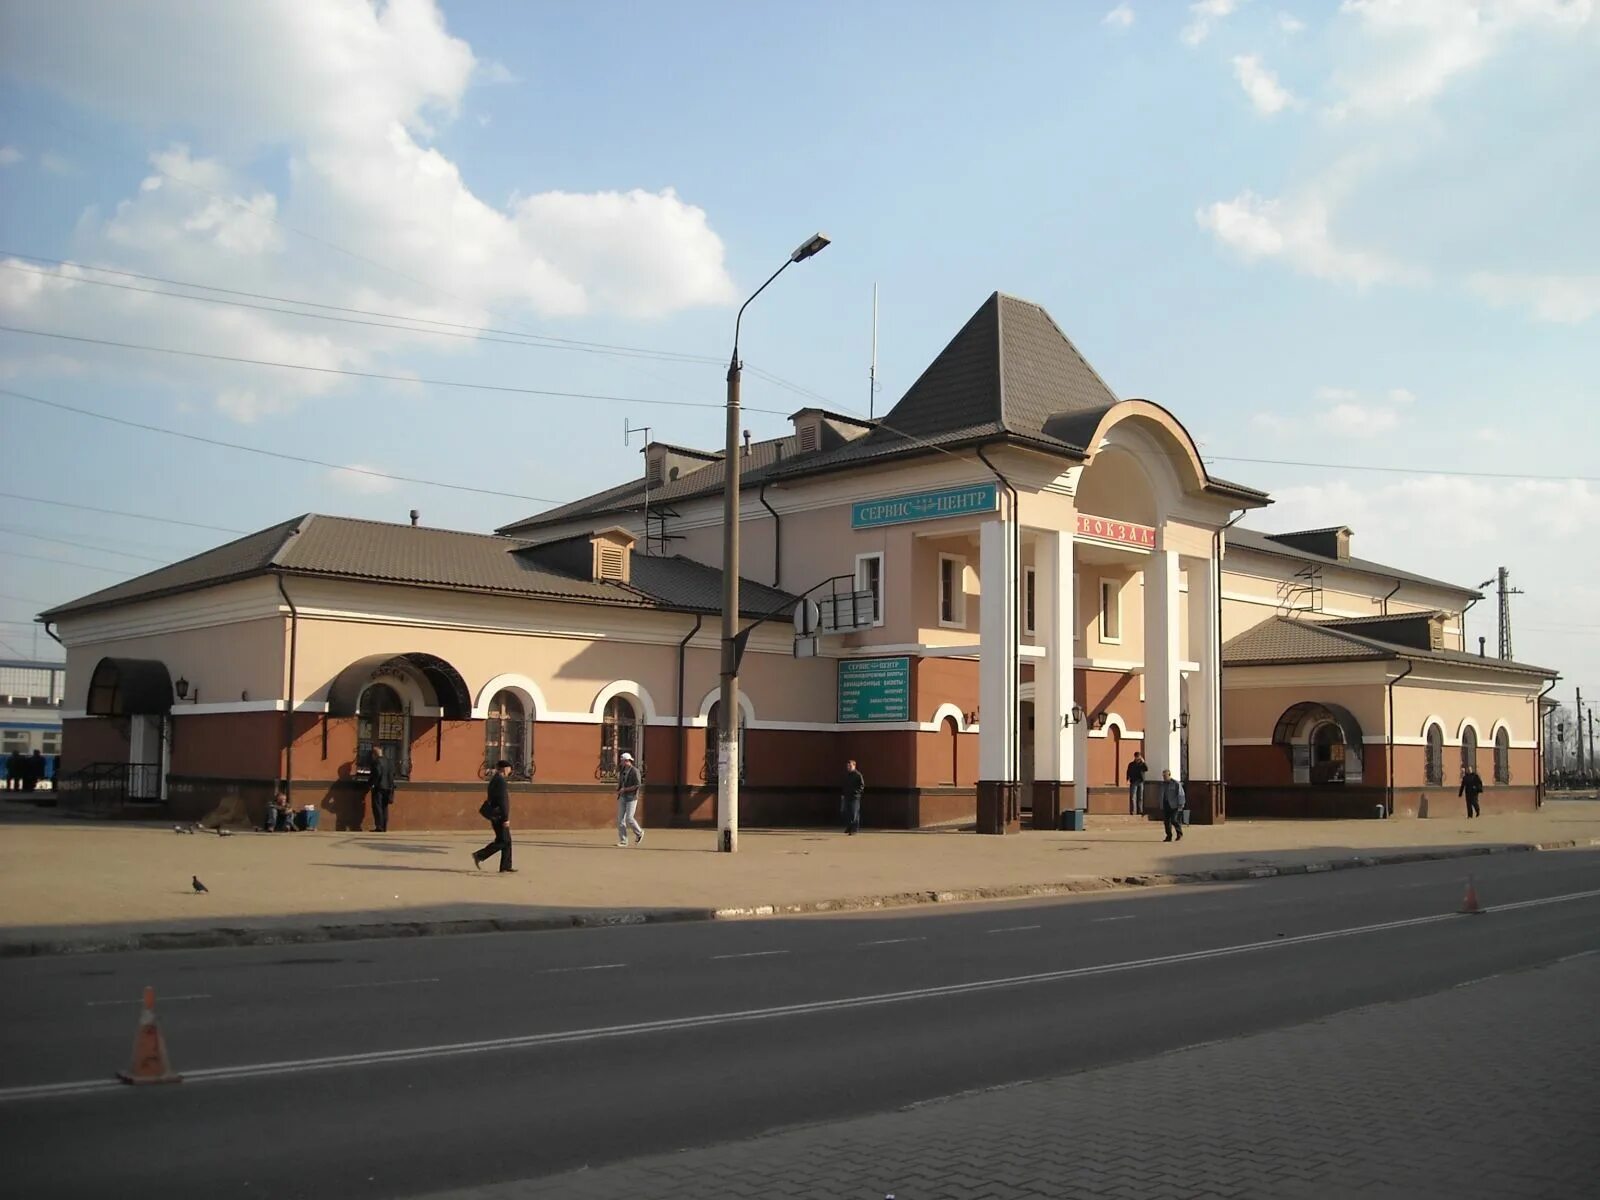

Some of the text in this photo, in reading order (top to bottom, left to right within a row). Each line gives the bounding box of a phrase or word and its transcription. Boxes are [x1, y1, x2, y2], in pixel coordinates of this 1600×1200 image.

[860, 491, 986, 521] СЕРВИС ЦЕНТР
[1083, 518, 1148, 543] ВОКЗАЛ
